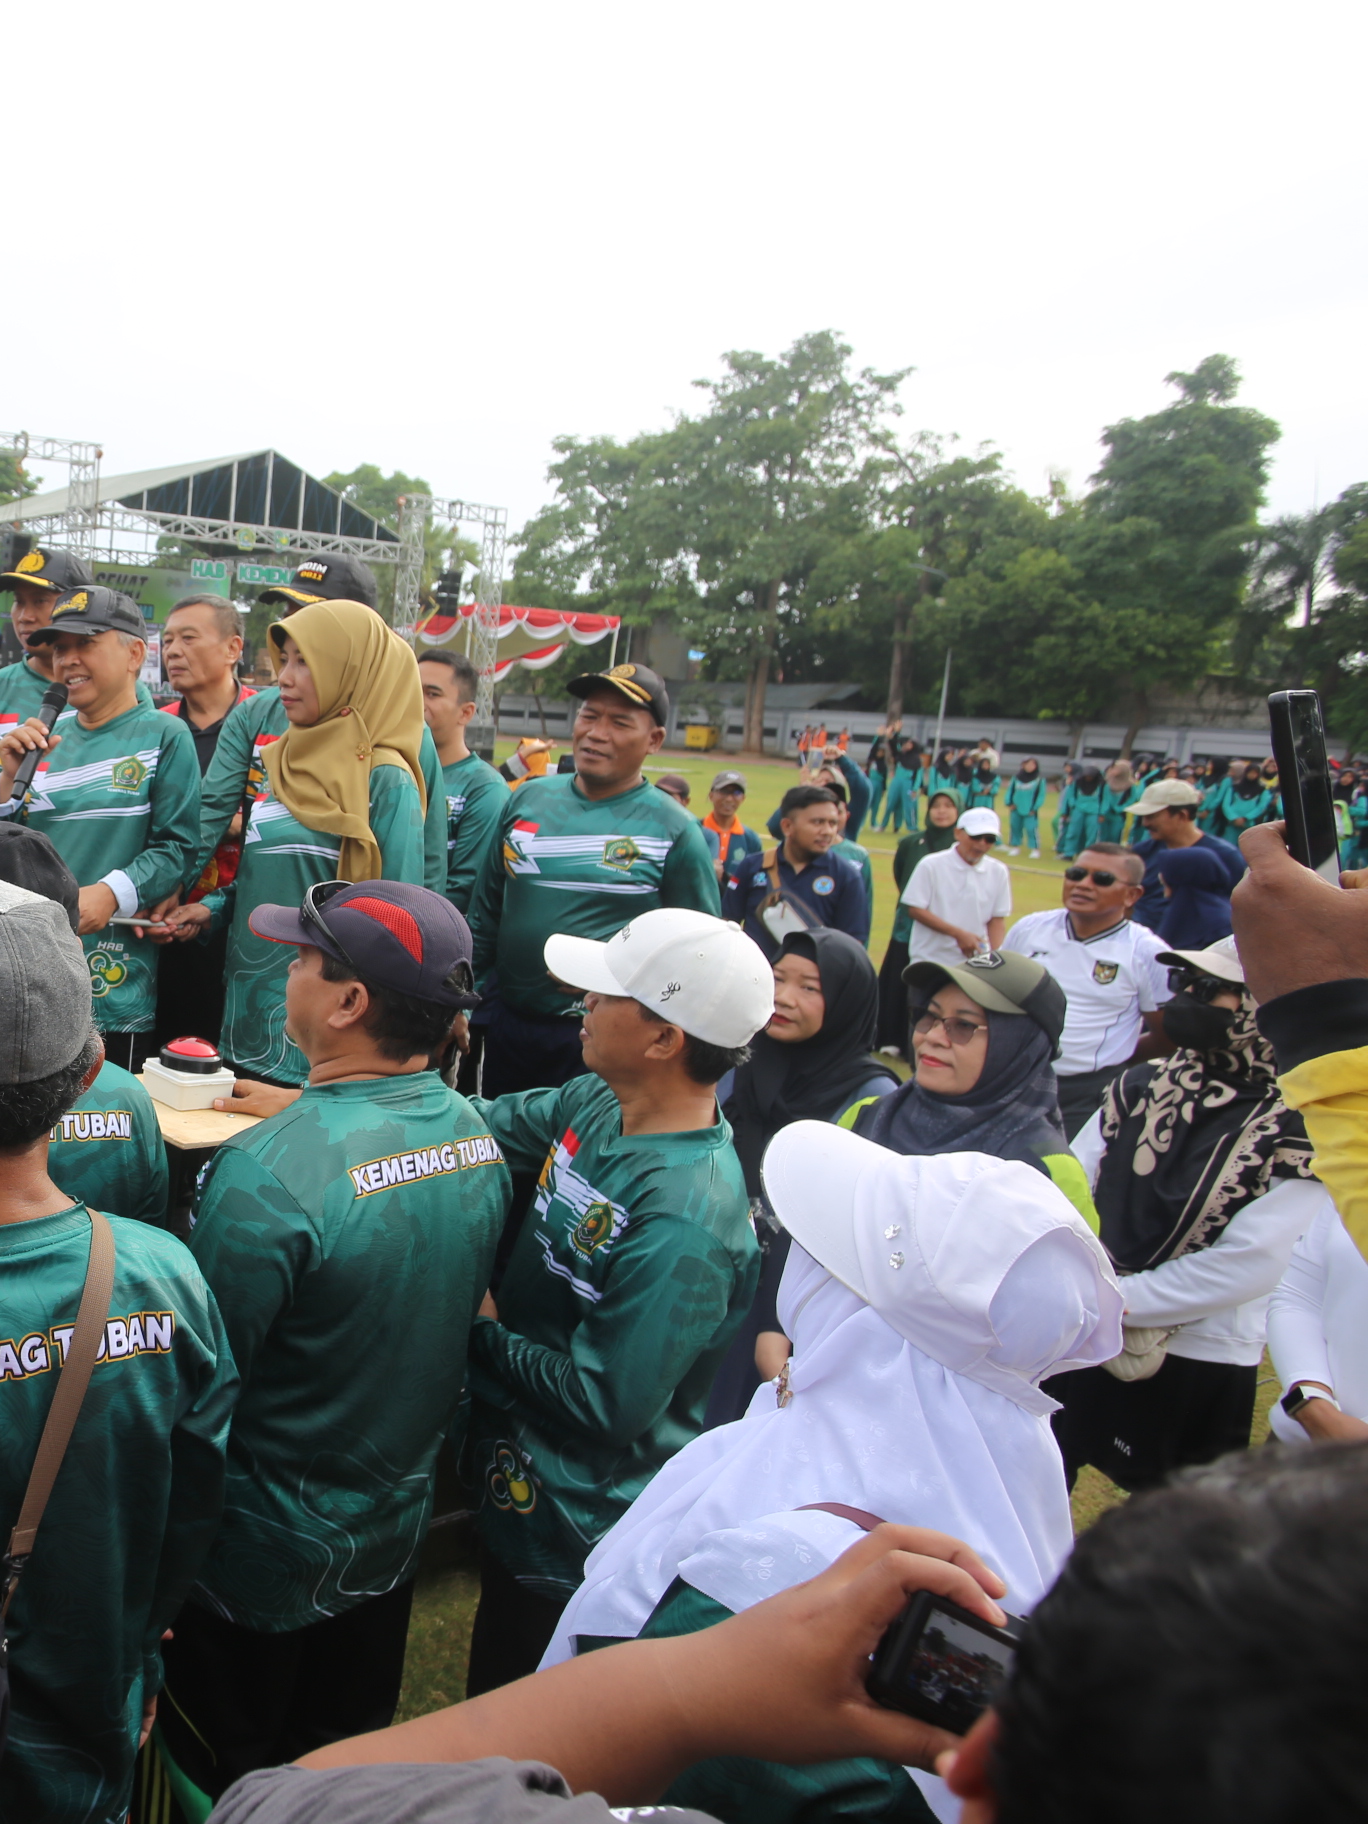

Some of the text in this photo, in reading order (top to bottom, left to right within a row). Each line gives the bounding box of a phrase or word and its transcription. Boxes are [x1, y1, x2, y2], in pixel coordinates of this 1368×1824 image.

[191, 558, 227, 580] HAB
[237, 562, 298, 586] KEMEN
[97, 941, 124, 952] HAB
[58, 1112, 132, 1140] TUBAN
[350, 1144, 457, 1197] KEMENAG
[49, 1312, 174, 1366] TBAN
